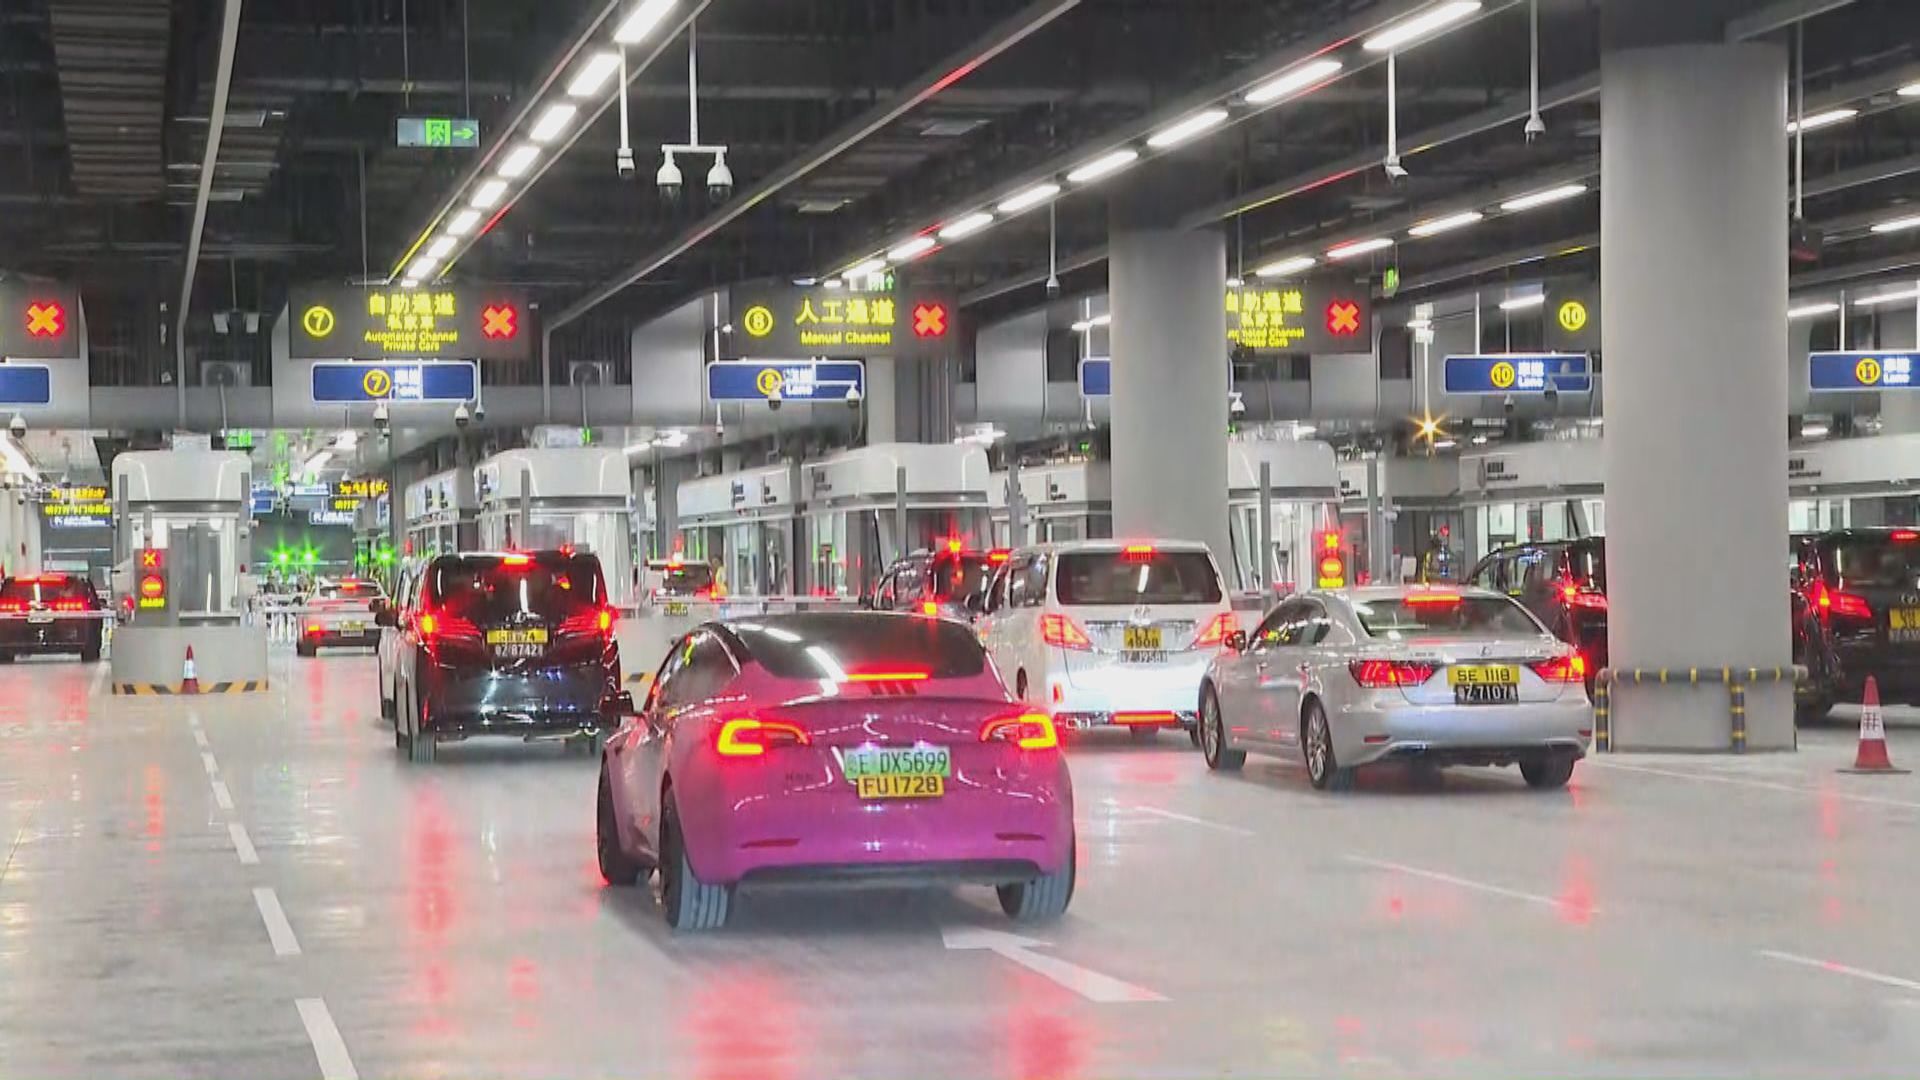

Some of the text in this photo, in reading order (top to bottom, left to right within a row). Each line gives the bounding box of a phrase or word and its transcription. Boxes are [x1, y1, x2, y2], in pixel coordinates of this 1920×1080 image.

[795, 299, 895, 325] 人工通道
[364, 330, 457, 342] Automated Channel
[800, 332, 891, 344] Manual Channel
[1268, 327, 1304, 338] Channel
[384, 341, 440, 352] Private Cars
[1268, 337, 1288, 347] Cars
[1457, 669, 1478, 682] SE
[880, 752, 947, 774] DX5699
